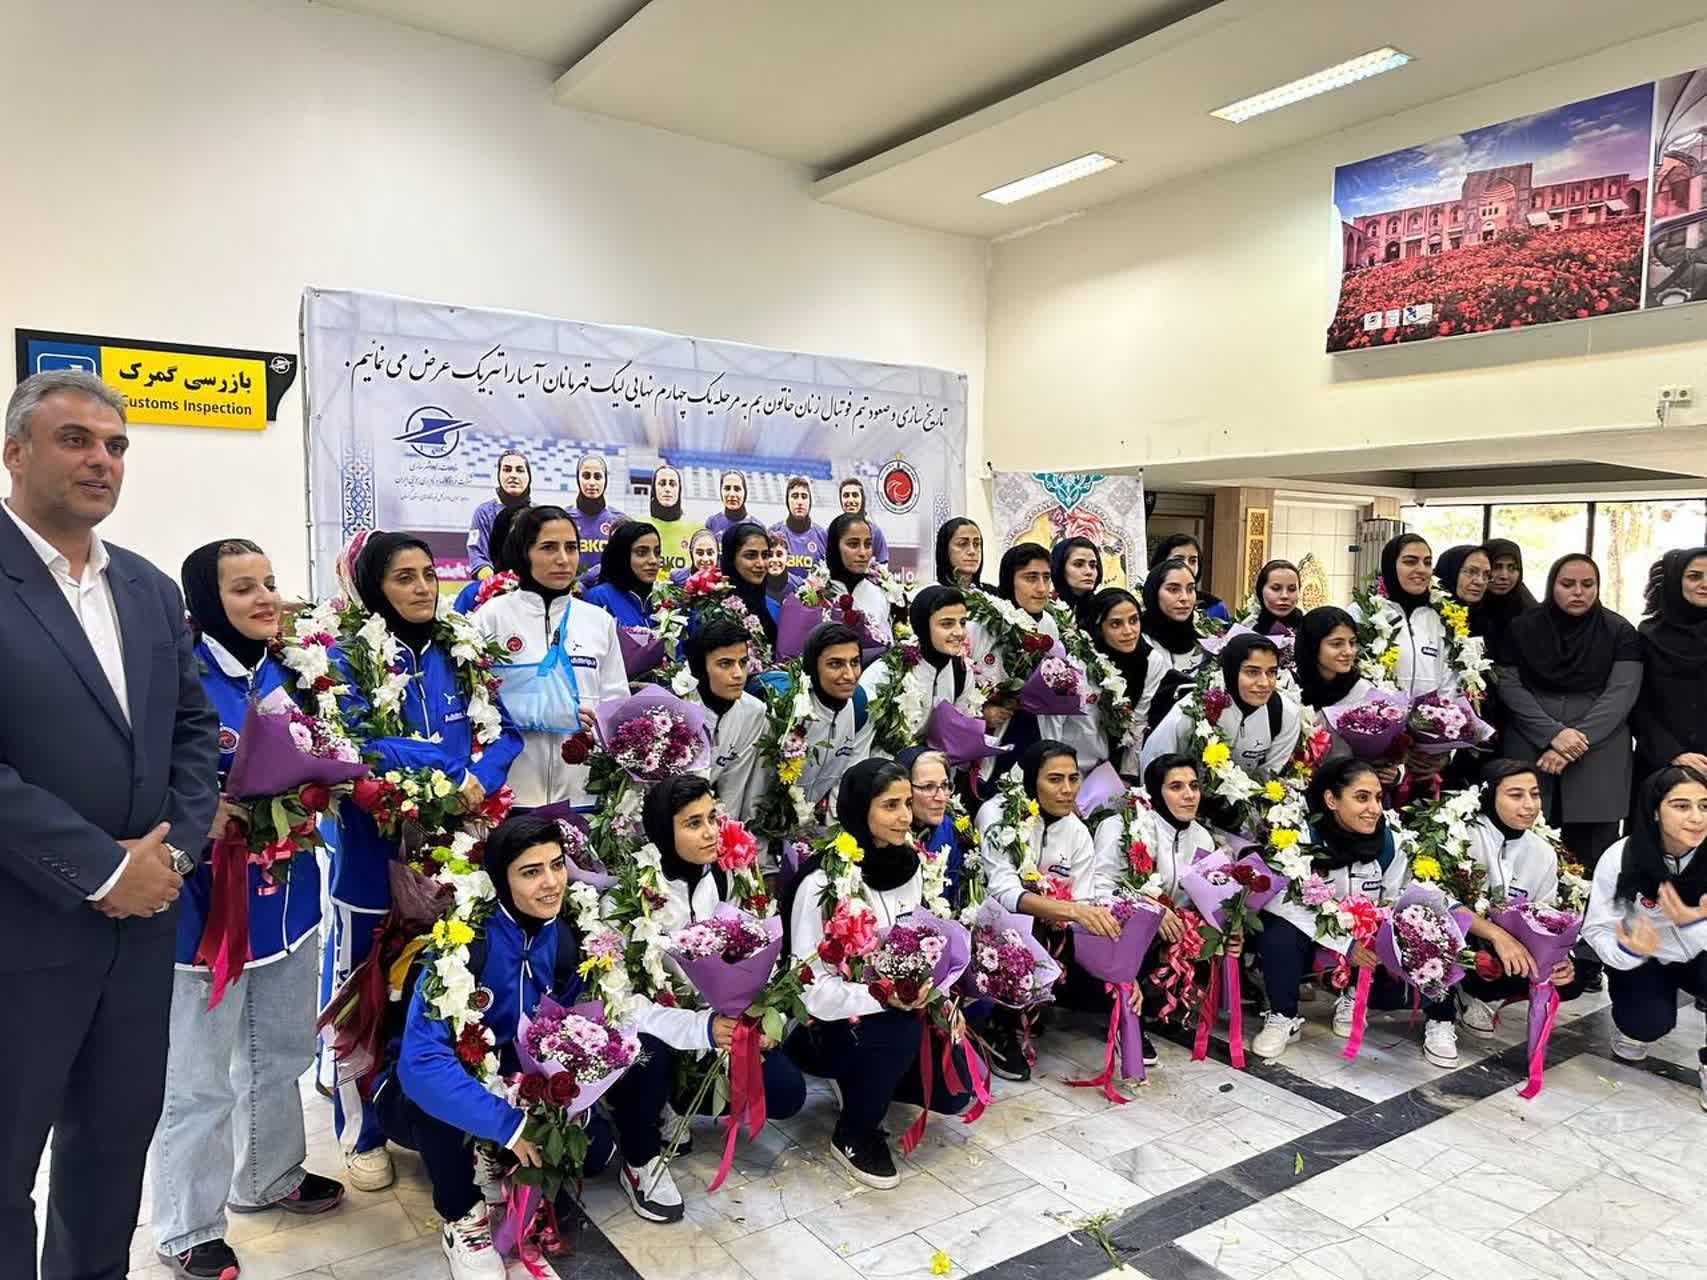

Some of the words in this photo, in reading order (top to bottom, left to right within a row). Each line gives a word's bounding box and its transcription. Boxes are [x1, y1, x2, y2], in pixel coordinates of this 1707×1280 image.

[119, 362, 177, 387] گمرک
[386, 353, 408, 379] می
[409, 347, 450, 383] عرض
[451, 343, 505, 396] تبریک
[542, 362, 591, 396] قهرمانان
[184, 370, 252, 394] بازرسی
[624, 374, 653, 409] نهایی
[687, 371, 726, 416] یک
[183, 399, 252, 416] Inspection
[654, 383, 687, 420] چهارم
[712, 389, 740, 412] مرحله
[741, 402, 748, 420] به
[748, 395, 762, 427] بم
[763, 386, 794, 416] خاتون
[794, 393, 821, 418] زنان
[820, 390, 852, 428] فوتبال
[868, 404, 890, 420] صعود
[851, 396, 869, 437] تیم
[891, 411, 896, 421] و
[896, 405, 923, 428] سازی
[922, 402, 948, 432] تاریخ
